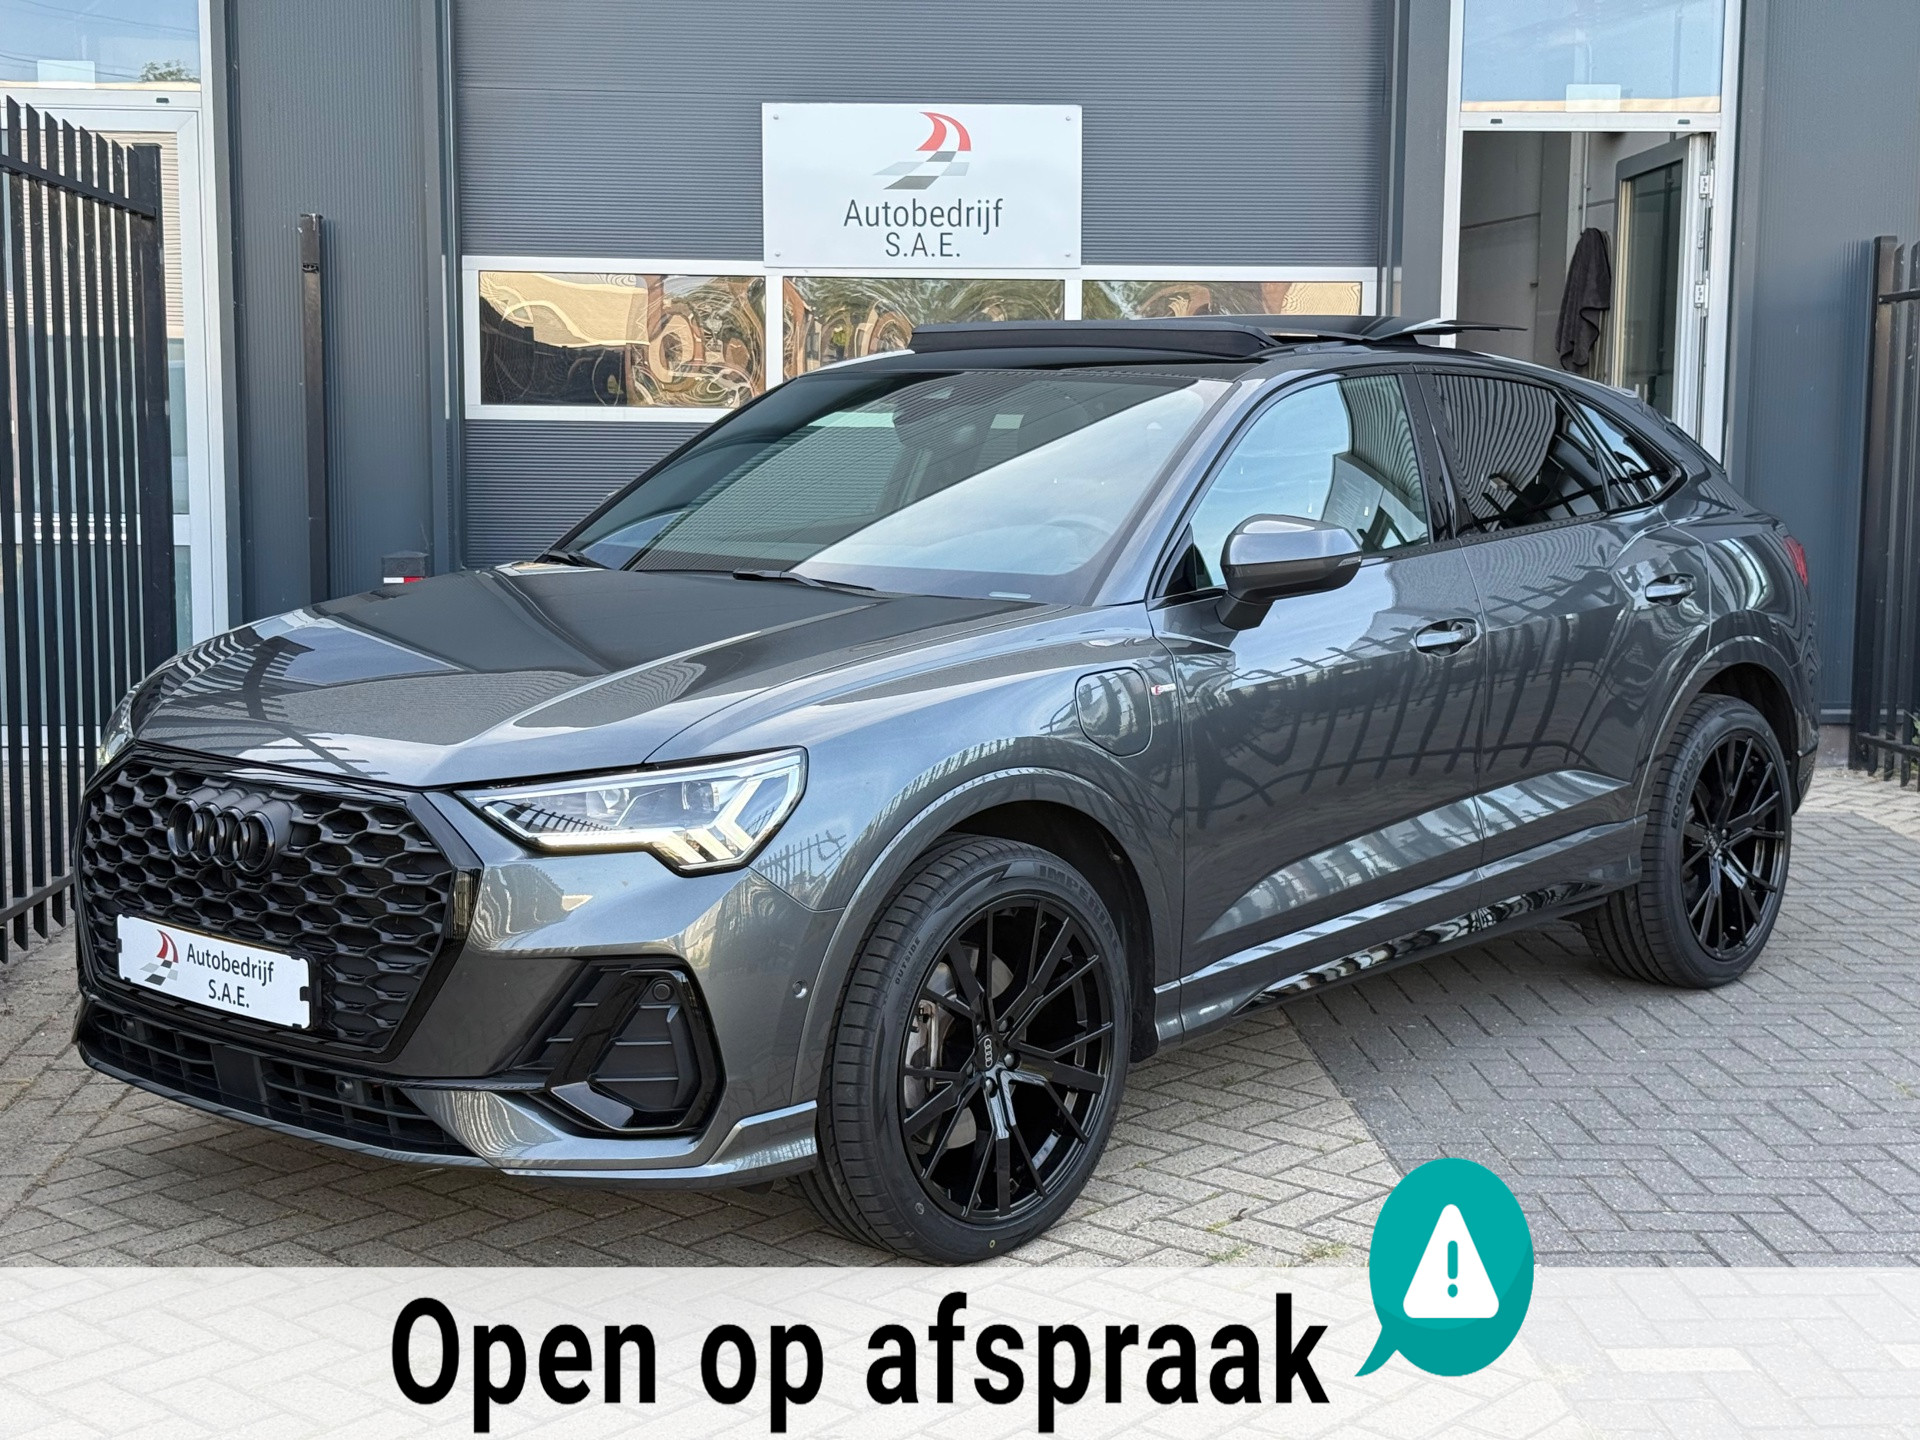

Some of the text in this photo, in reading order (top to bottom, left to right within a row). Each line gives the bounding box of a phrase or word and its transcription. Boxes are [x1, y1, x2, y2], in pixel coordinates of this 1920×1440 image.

[843, 198, 1004, 236] Autobedrijf
[885, 232, 961, 258] S.A.E.
[186, 943, 275, 987] Autobedrijf
[894, 936, 921, 986] OUTSIDE
[207, 978, 250, 1009] S.A.E.
